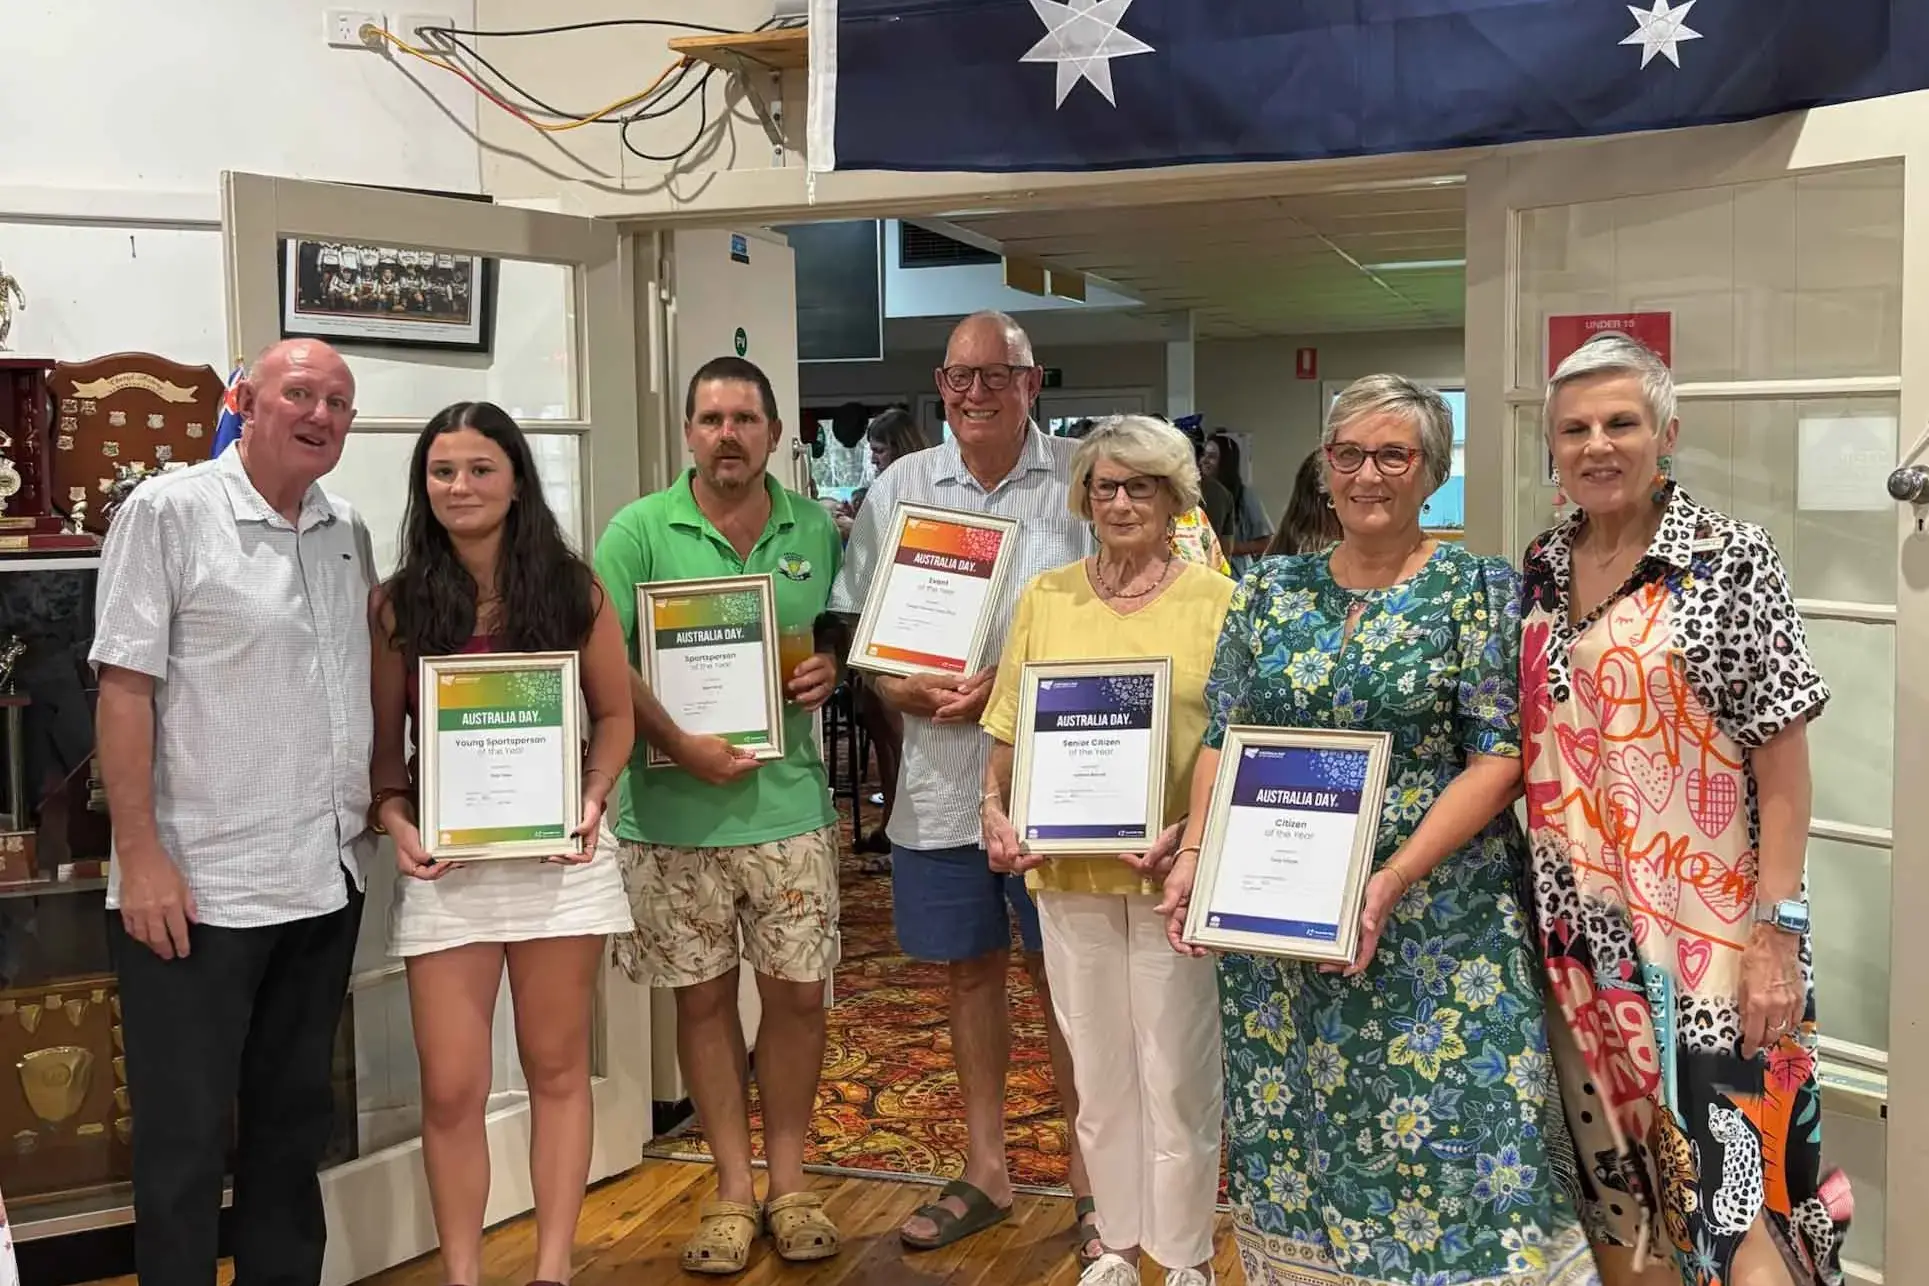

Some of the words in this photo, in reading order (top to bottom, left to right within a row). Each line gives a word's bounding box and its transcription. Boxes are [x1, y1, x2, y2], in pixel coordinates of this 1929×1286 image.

[914, 552, 957, 570] AUSTRALIA
[677, 629, 724, 644] AUSTRALIA
[684, 653, 736, 663] Sportsperson
[462, 711, 516, 725] AUSTRALIA
[1057, 714, 1109, 727] AUSTRALIA
[455, 739, 484, 748] Young
[486, 737, 546, 747] Sportsperson
[1062, 739, 1090, 747] Senior
[1091, 738, 1121, 746] Citizen
[1256, 788, 1313, 806] AUSTRALIA
[1274, 818, 1307, 828] Citizen
